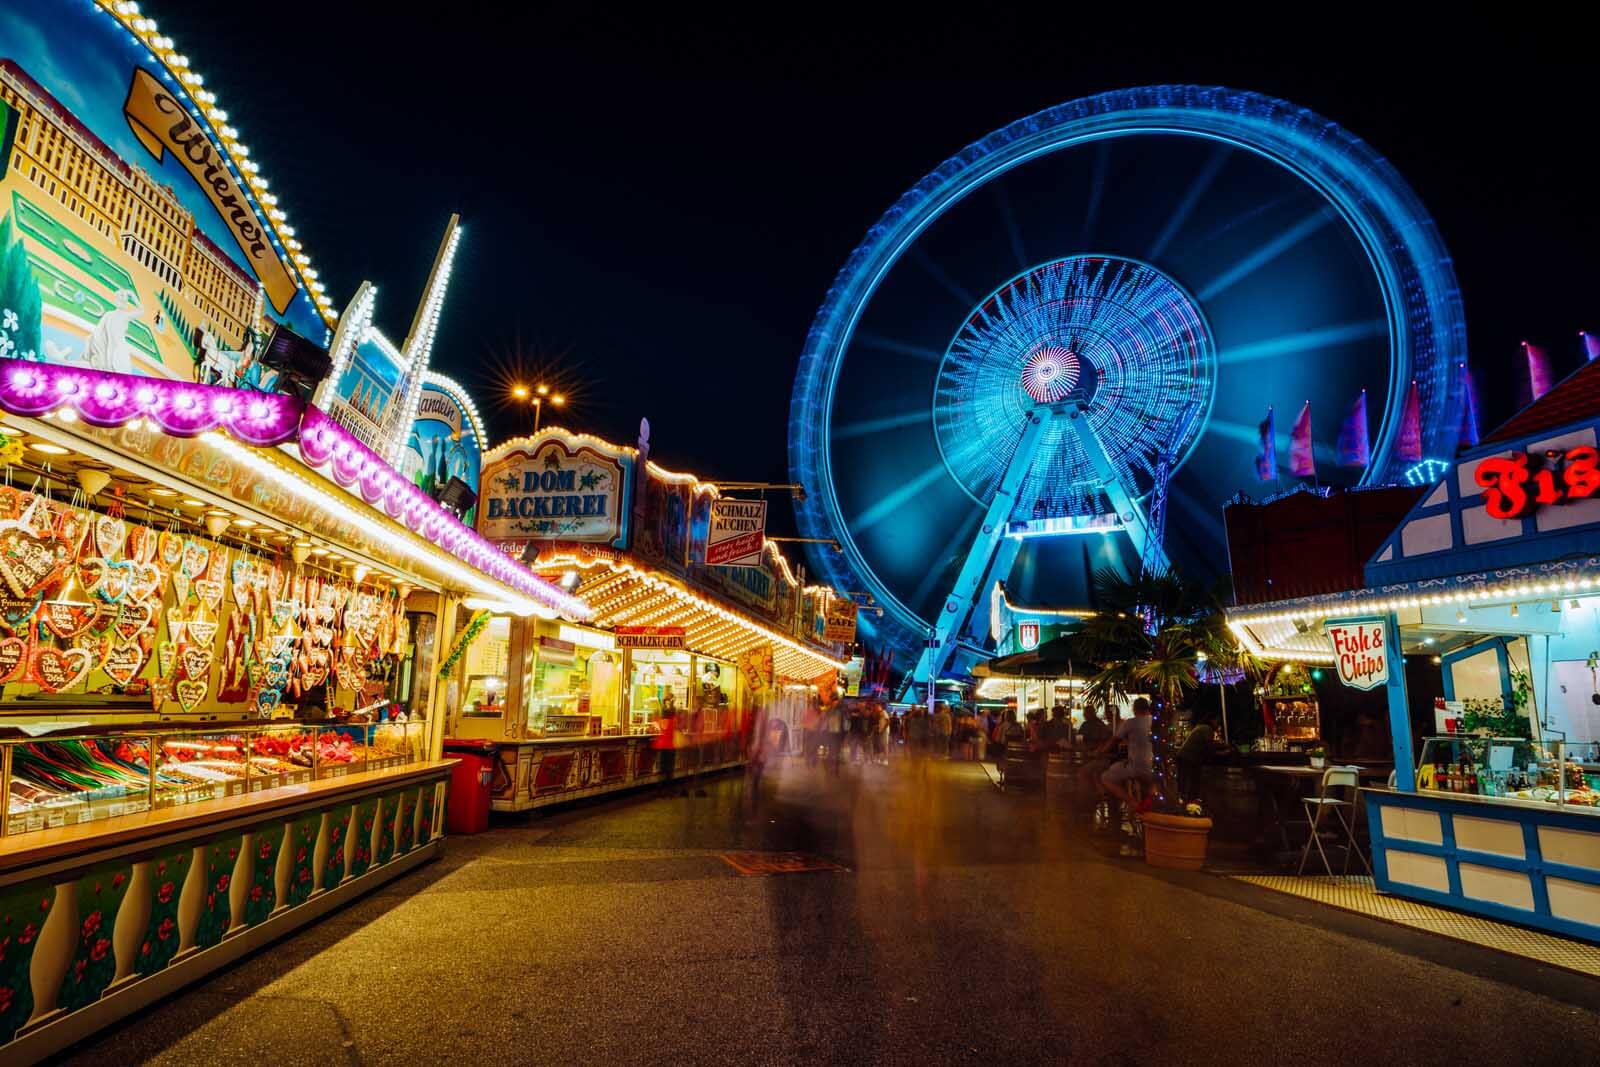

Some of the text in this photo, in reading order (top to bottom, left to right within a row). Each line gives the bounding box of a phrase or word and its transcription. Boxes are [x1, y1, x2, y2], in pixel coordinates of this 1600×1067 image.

[154, 93, 266, 259] Wiener
[522, 470, 577, 492] DOM
[487, 494, 608, 520] BÄCKEREI
[714, 504, 762, 518] SCHMALZ
[715, 518, 758, 531] KUCHEN
[616, 635, 684, 648] SCHMALZKUCHEN
[1330, 626, 1384, 655] Fish &
[1340, 654, 1384, 682] Chips
